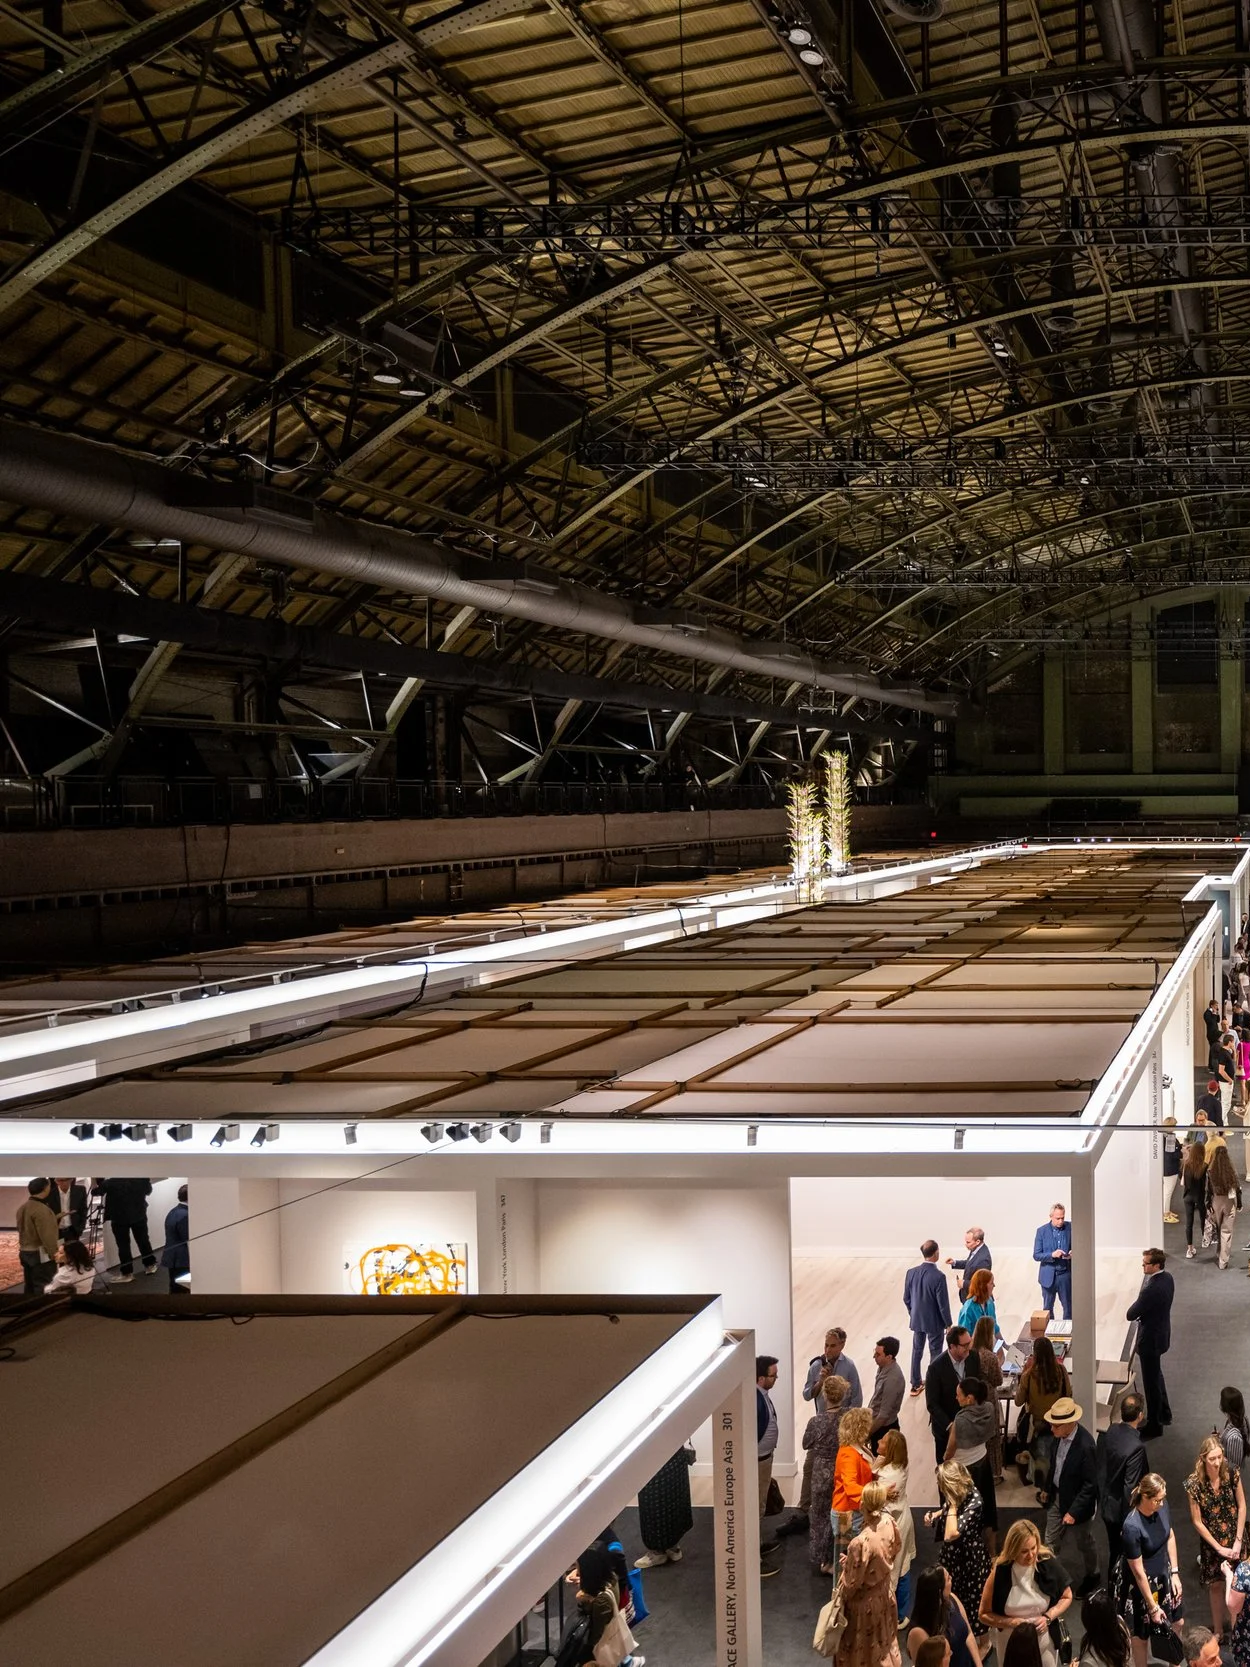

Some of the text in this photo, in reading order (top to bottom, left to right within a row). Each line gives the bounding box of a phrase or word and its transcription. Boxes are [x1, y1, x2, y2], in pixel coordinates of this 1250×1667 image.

[722, 1412, 733, 1431] 301
[723, 1440, 733, 1464] Asia
[724, 1466, 736, 1506] Europe
[724, 1509, 735, 1555] America
[725, 1558, 736, 1590] North
[726, 1593, 738, 1646] GALLERY,
